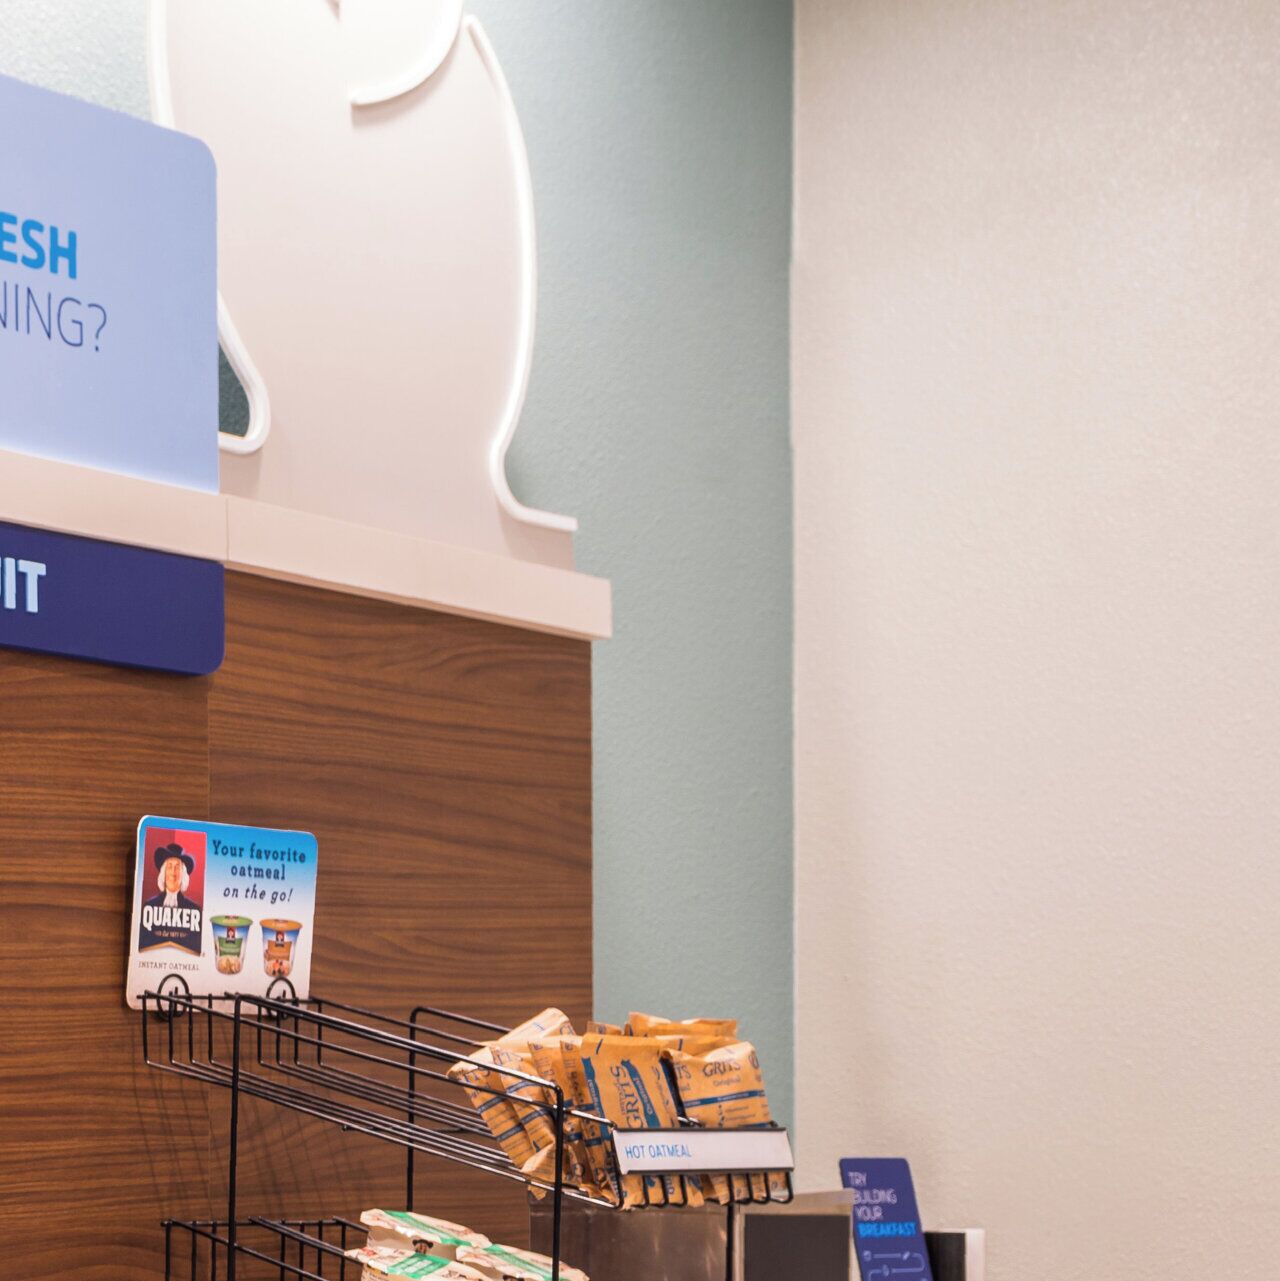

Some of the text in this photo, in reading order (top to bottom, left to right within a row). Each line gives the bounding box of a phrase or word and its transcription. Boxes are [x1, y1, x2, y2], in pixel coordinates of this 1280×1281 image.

[212, 839, 306, 863] Your favorite
[231, 864, 286, 881] oatmeal
[223, 884, 293, 905] on the go!
[142, 905, 201, 932] QUAKER
[625, 1144, 693, 1159] HOT OATMEAL
